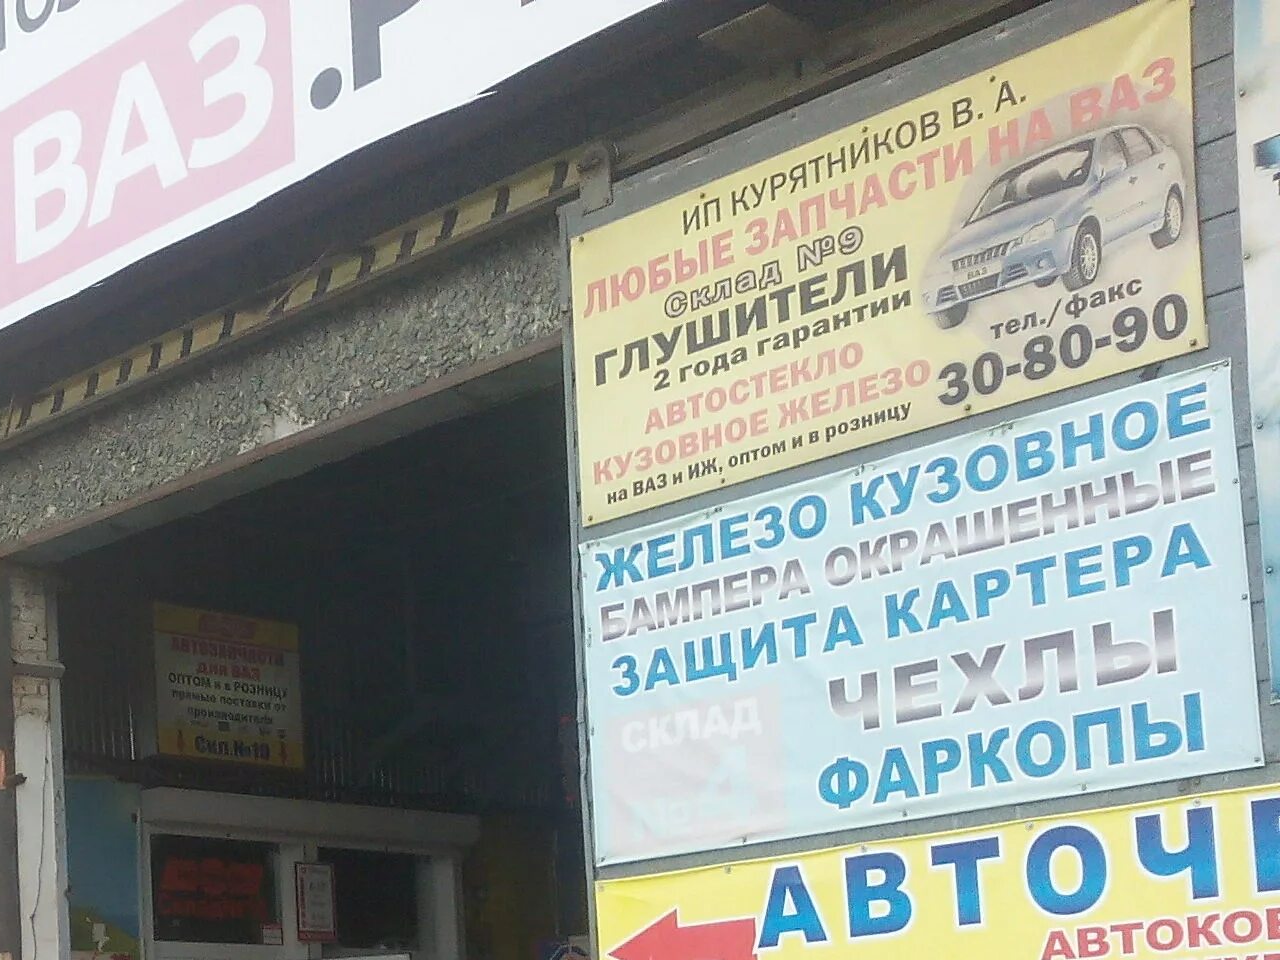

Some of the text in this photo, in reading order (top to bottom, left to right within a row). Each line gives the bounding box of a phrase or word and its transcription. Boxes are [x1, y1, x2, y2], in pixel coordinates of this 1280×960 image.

[583, 57, 1177, 318] ЛЮБЫЕ ЗАПЧАСТИ НА ВАЗ
[683, 80, 1027, 236] ИП КУРЯТНИКОВ В. А.
[594, 245, 908, 386] ГЛУШИТЕЛИ
[664, 226, 864, 319] Склад №9
[990, 275, 1143, 340] тел./факс
[645, 341, 864, 435] АВТОСТЕКЛО
[653, 289, 913, 391] 2 года гарантии
[936, 293, 1189, 406] 30-80-90
[594, 358, 931, 486] КУЗОВНОЕ ЖЕЛЕЗО
[607, 402, 912, 504] на ВАЗ и ИЖ, оптом и в розницу
[594, 383, 1212, 592] ЖЕЛЕЗО КУЗОВНОЕ
[600, 449, 1216, 644] БАМПЕРА ОКРАШЕННЫЕ
[612, 523, 1211, 697] ЗАЩИТА КАРТЕРА
[828, 609, 1179, 731] ЧЕХЛЫ
[621, 696, 762, 753] СКЛАД
[818, 692, 1204, 810] ФАРКОПЫ
